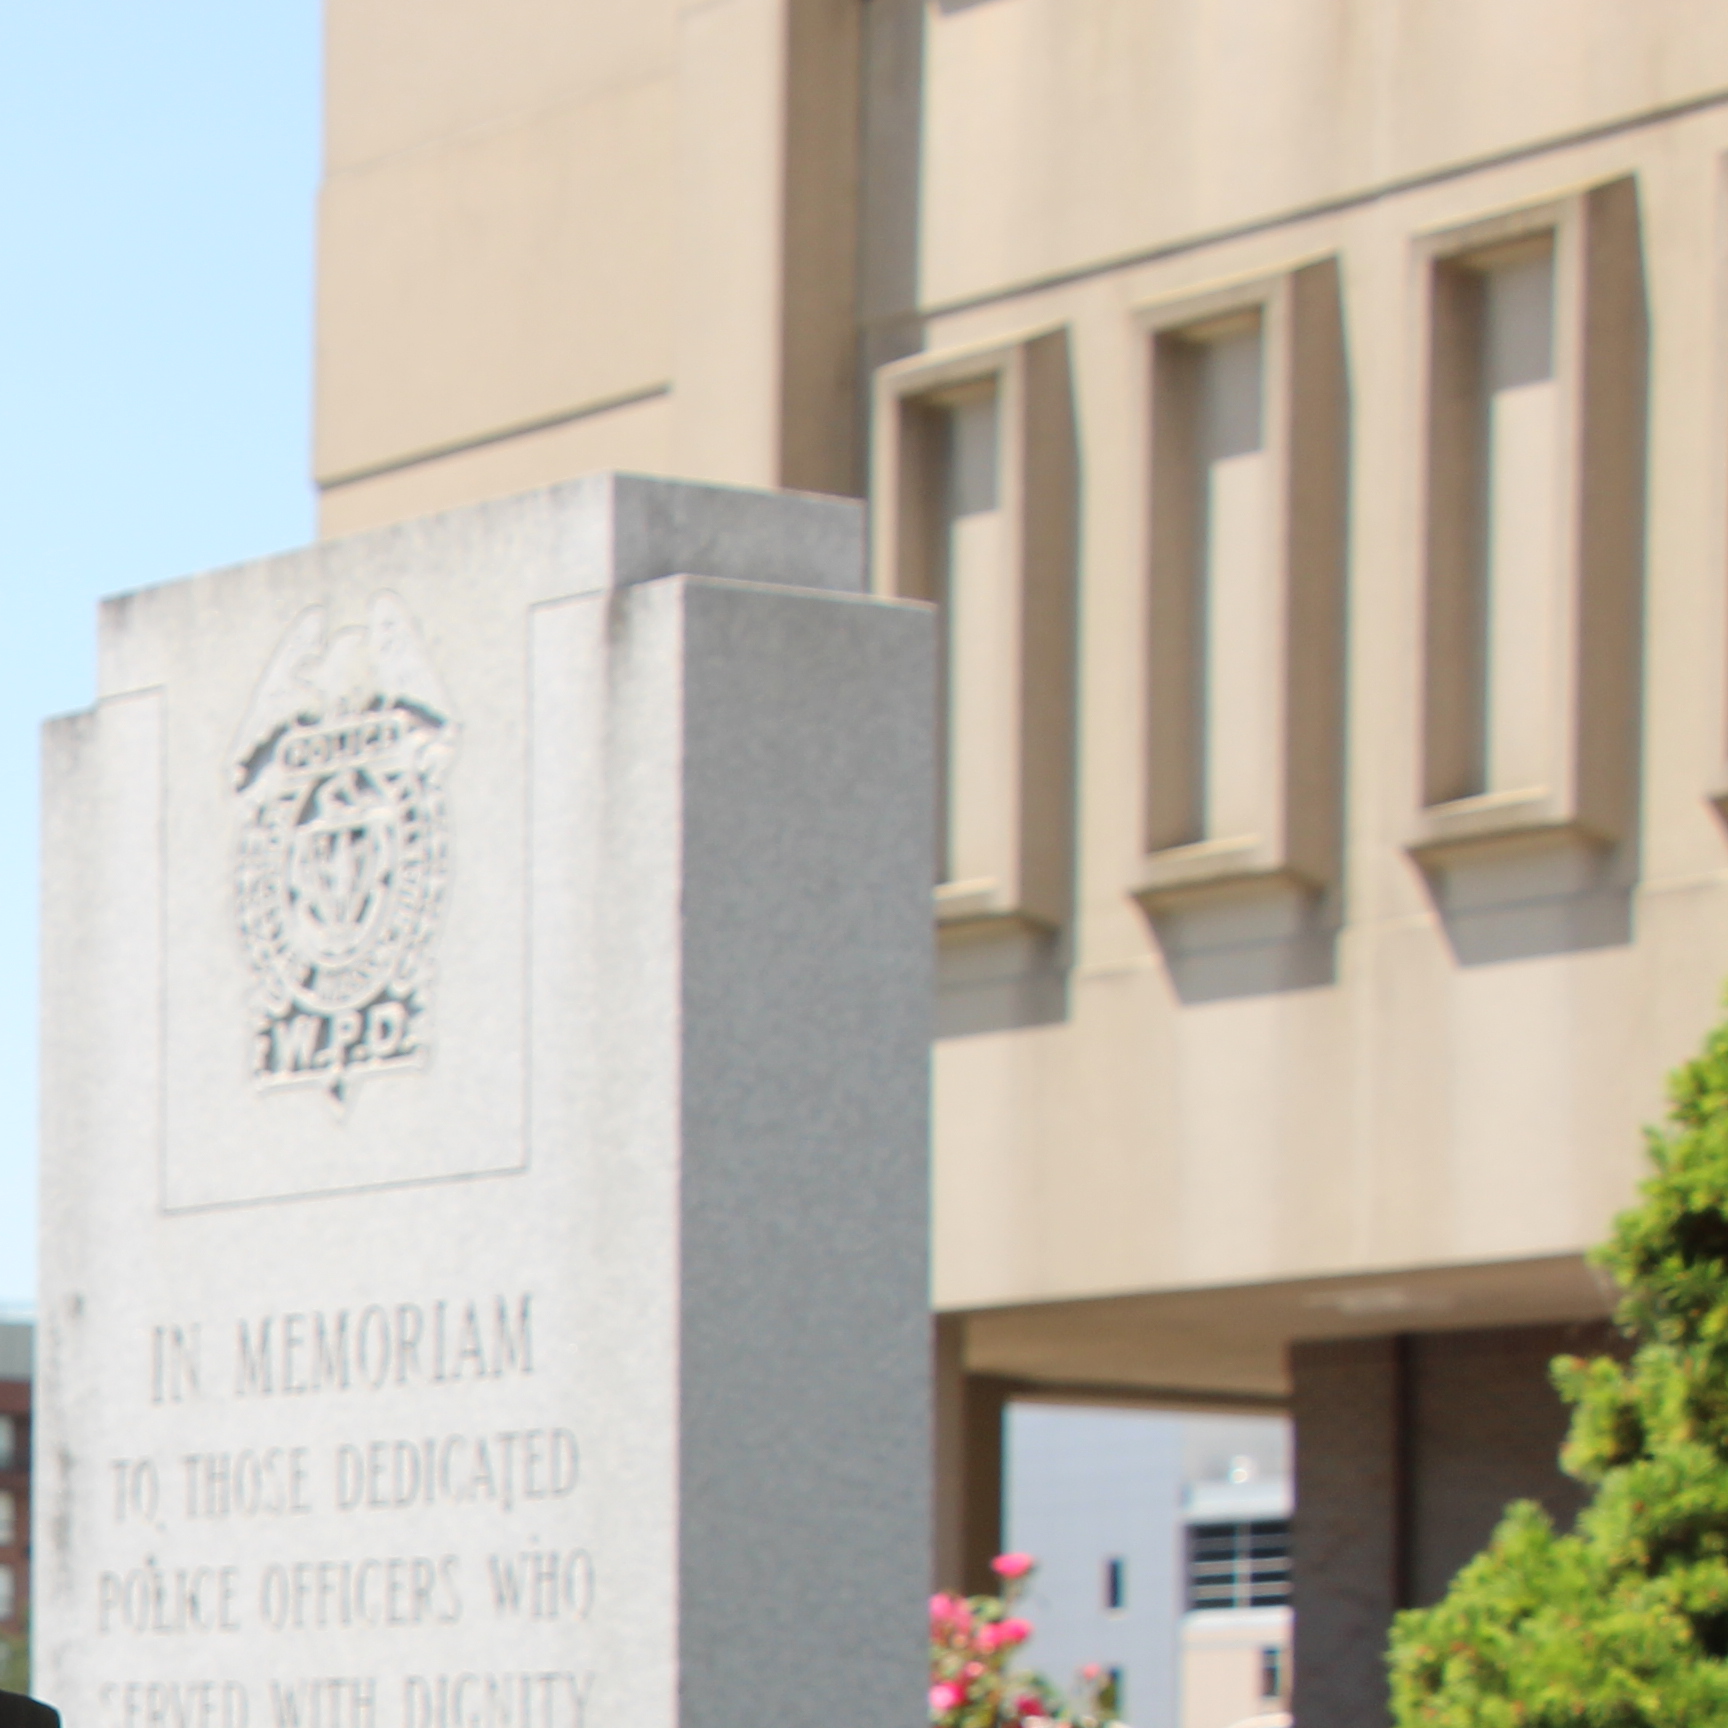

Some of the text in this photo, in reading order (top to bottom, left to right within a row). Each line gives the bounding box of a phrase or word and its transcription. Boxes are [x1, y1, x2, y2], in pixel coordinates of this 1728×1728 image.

[150, 1290, 536, 1407] IN MEMORIAM
[110, 1426, 581, 1524] TO THOSE DEDICATED
[97, 1547, 598, 1635] POLICE OFFICERS WHO
